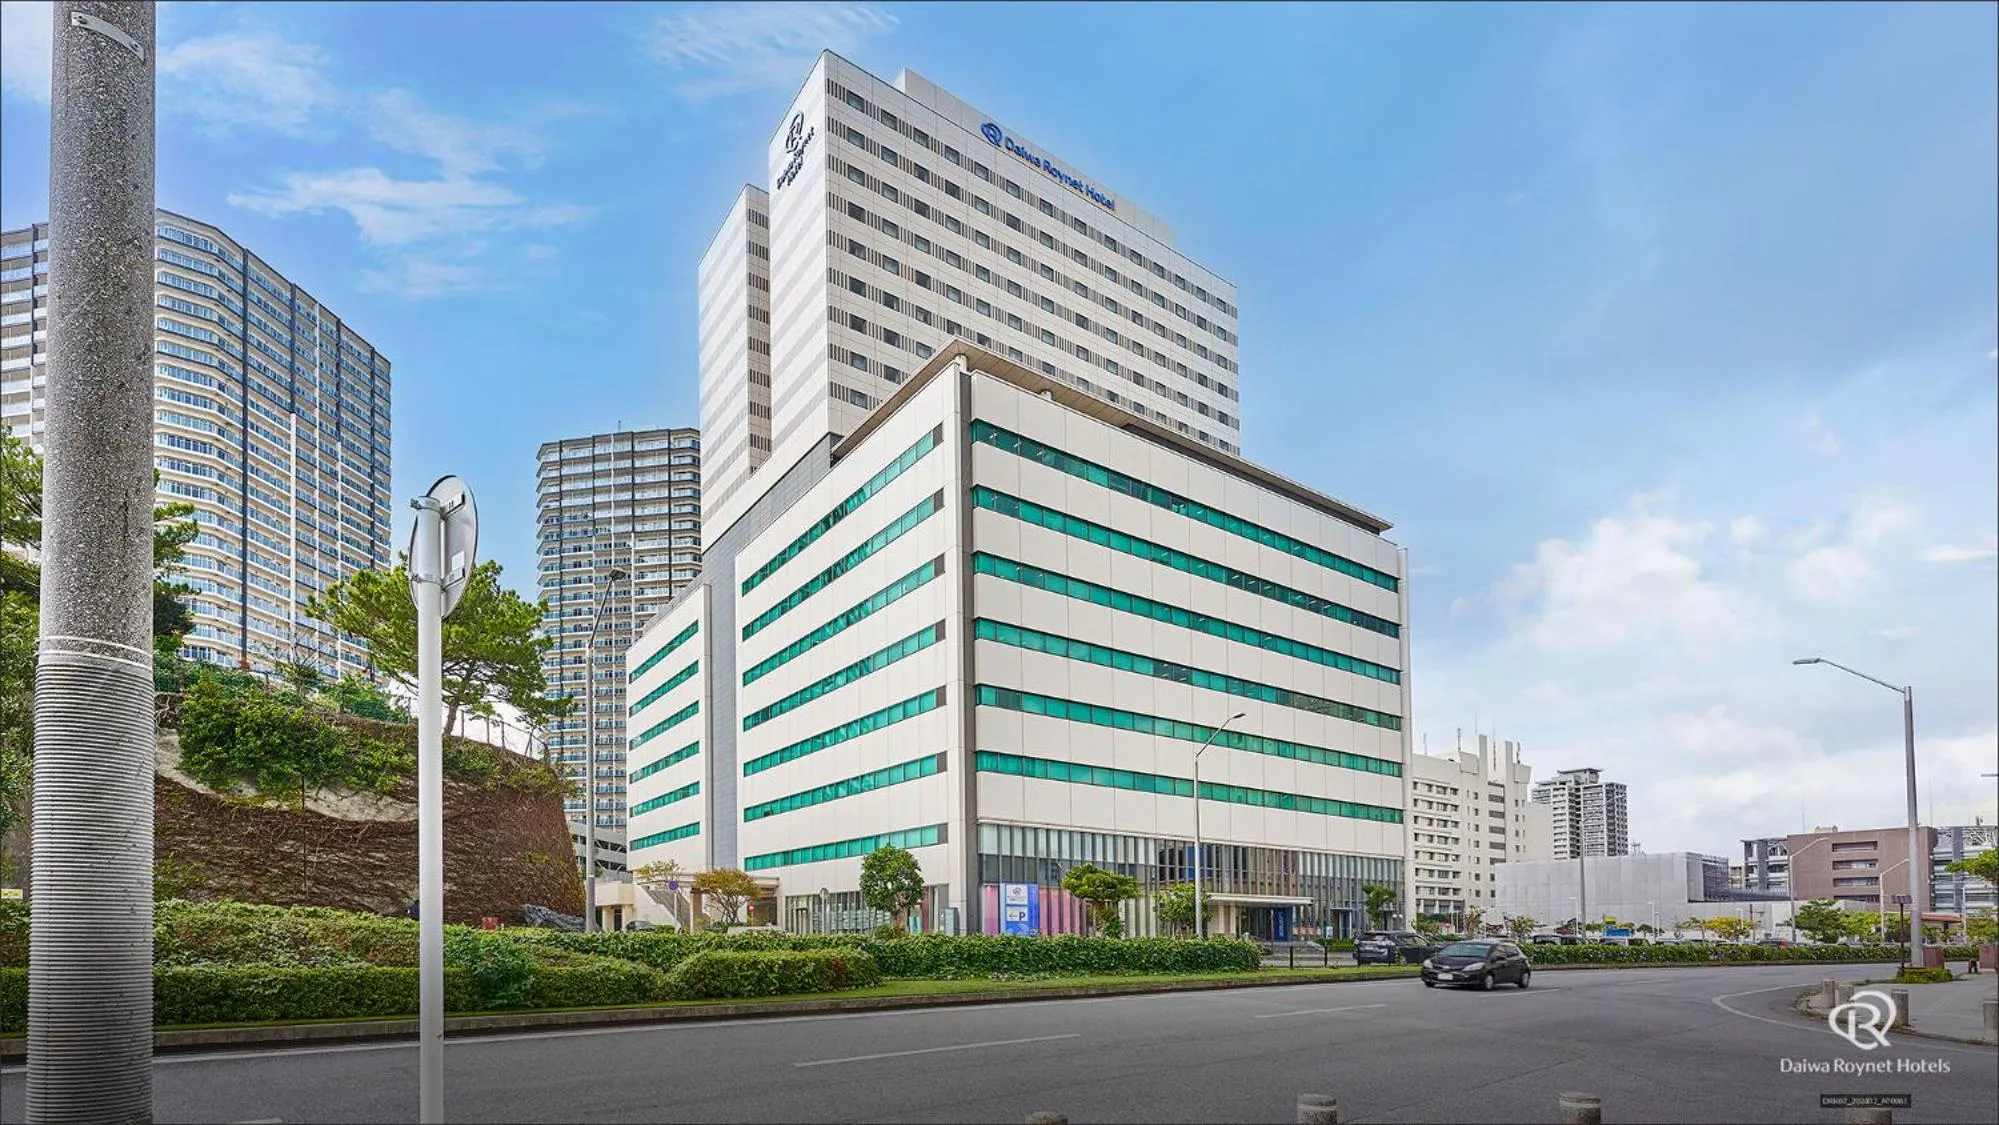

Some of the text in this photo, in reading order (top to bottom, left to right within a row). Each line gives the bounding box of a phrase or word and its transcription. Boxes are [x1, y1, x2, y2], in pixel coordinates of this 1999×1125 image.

[1004, 136, 1115, 211] Daiwa Roynet Hotel
